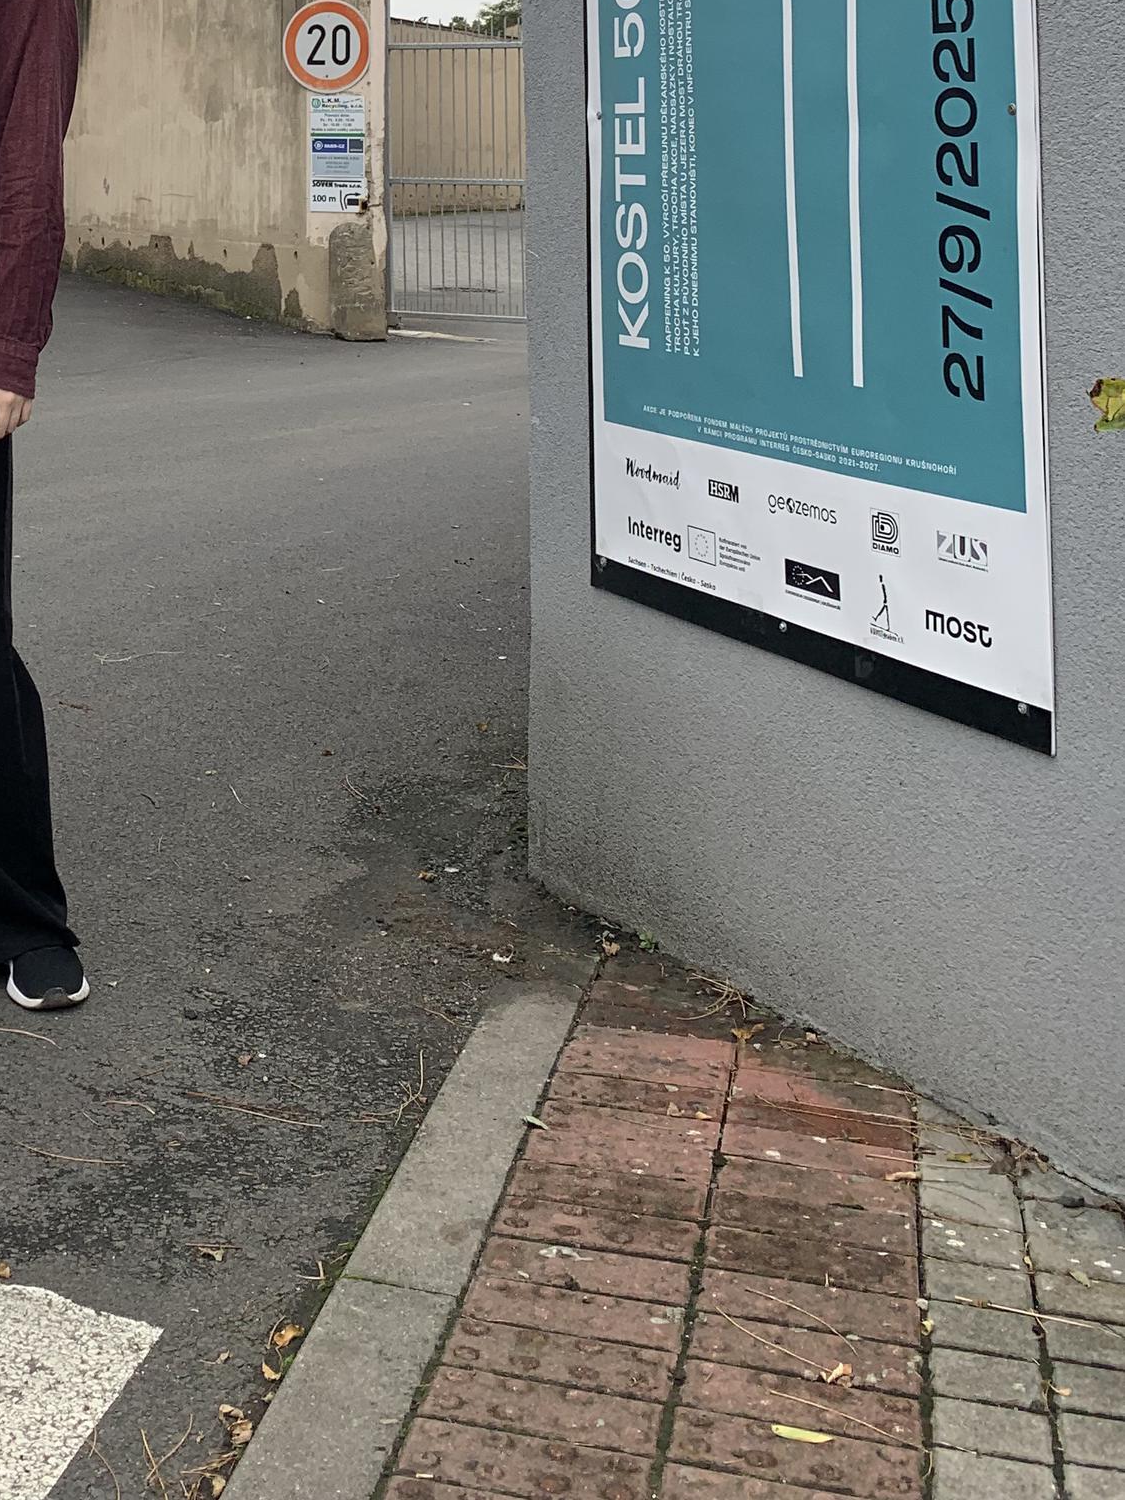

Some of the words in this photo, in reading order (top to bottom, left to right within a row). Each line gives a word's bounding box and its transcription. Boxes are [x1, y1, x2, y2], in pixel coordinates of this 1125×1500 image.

[306, 23, 351, 66] 20
[685, 12, 694, 93] INFOCENTRU
[688, 96, 694, 105] V
[679, 121, 687, 170] JEZERA
[681, 173, 687, 182] U
[312, 194, 327, 202] 100
[614, 76, 650, 350] KOSTEL
[664, 266, 670, 275] K
[664, 278, 672, 353] HAPPENING
[683, 308, 689, 316] Z
[693, 349, 699, 357] K
[659, 408, 665, 416] JE
[851, 448, 902, 464] EUROREGIONU
[724, 432, 757, 445] PROGRAMU
[759, 440, 790, 452] INTERREG
[709, 479, 739, 504] HSRM
[628, 516, 681, 552] Interreg
[873, 542, 899, 554] DIAMO
